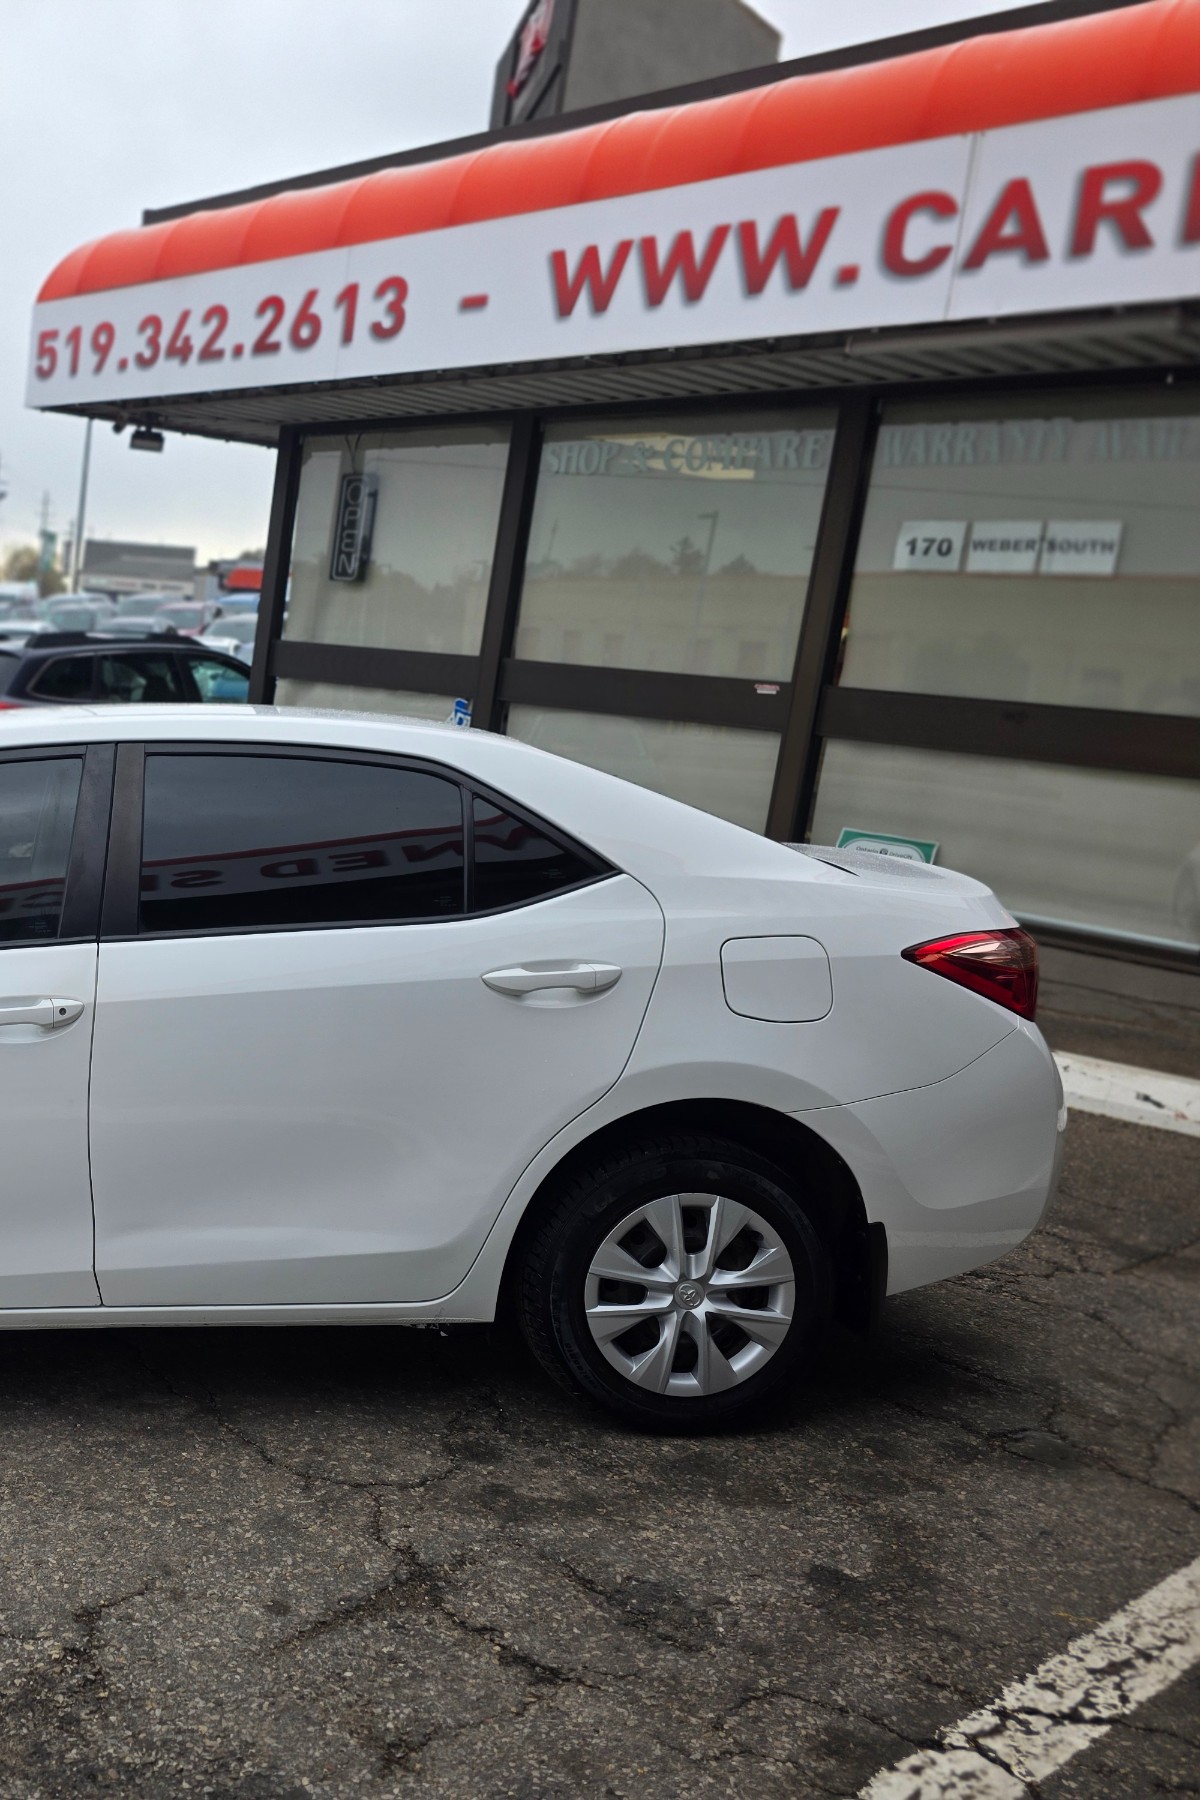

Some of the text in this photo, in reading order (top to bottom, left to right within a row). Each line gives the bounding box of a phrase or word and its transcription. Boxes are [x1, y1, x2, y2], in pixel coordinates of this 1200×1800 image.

[35, 275, 410, 379] 519.342.2613
[546, 441, 619, 475] SHOP
[665, 434, 826, 473] COMPARE
[338, 482, 363, 575] OPEN
[905, 537, 1115, 557] 170 WEBER SOUTH
